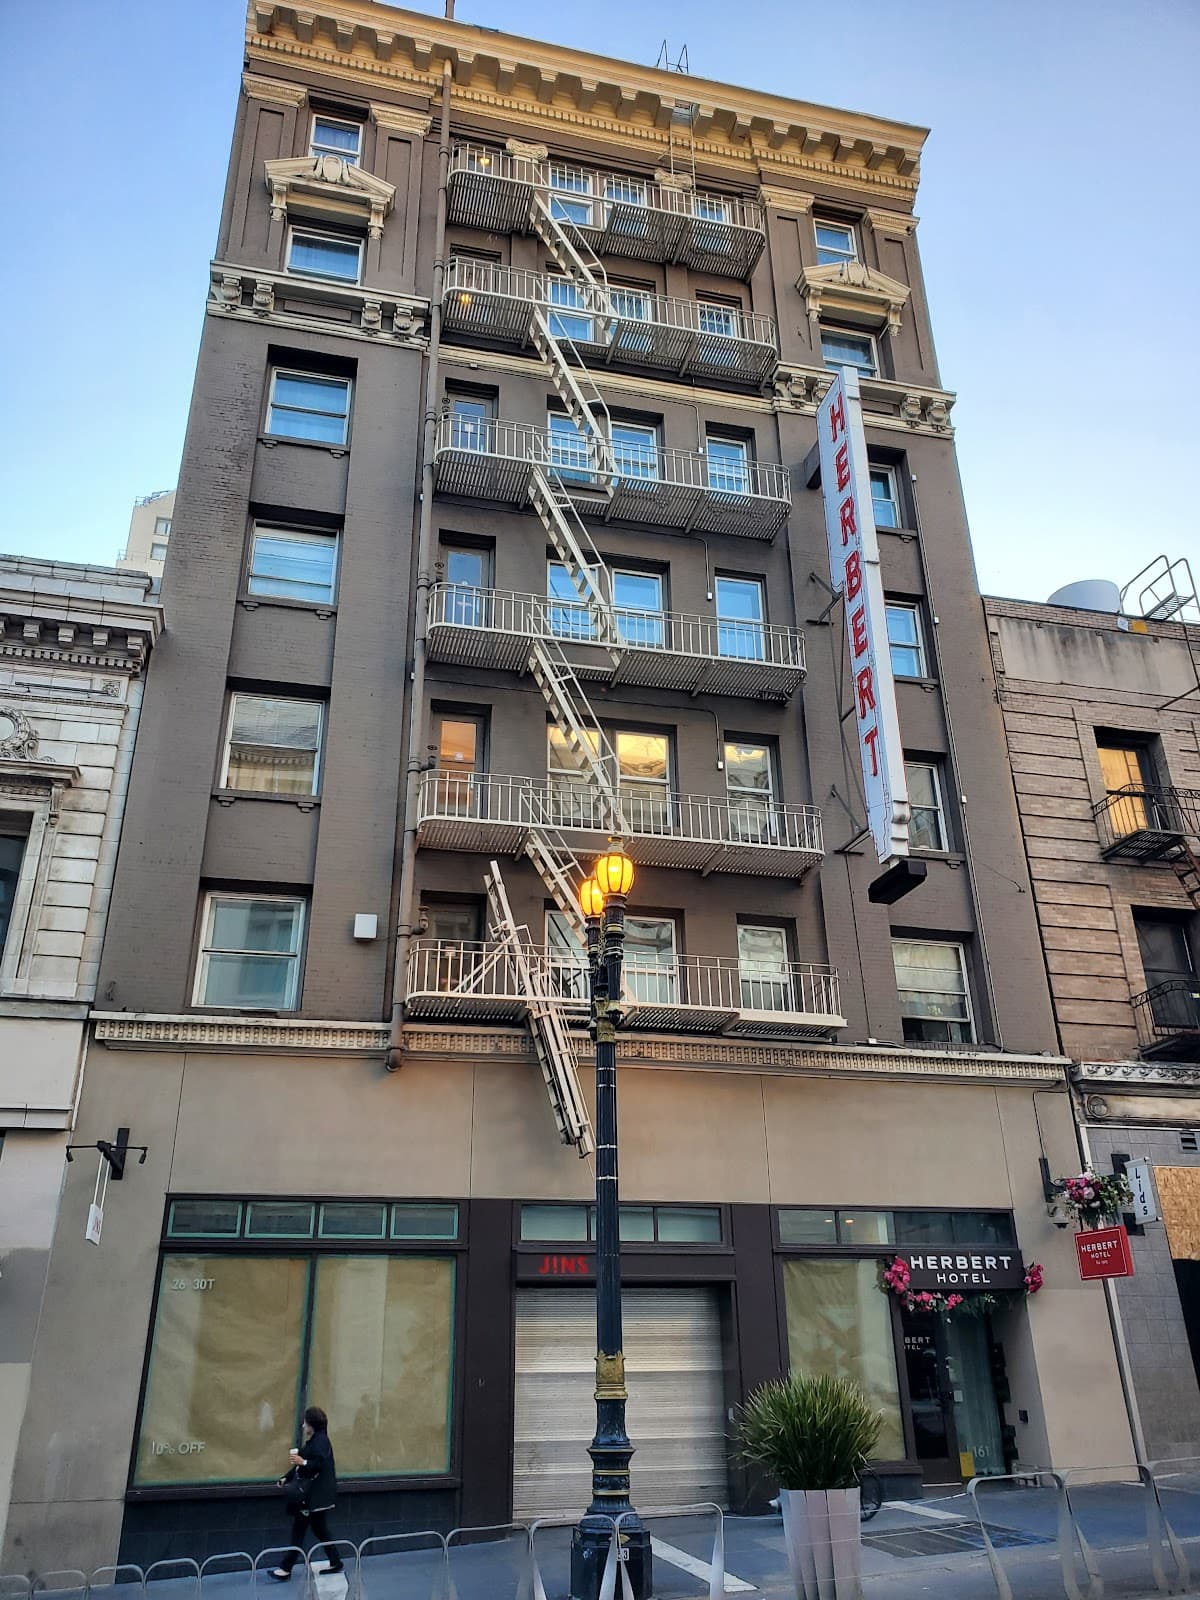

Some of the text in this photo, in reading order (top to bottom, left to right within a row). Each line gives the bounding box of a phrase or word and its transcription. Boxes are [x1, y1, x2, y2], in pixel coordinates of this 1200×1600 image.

[827, 391, 878, 777] HERBERT
[1135, 1167, 1148, 1216] Lids
[1080, 1240, 1118, 1253] HERBERT
[1090, 1250, 1112, 1259] HOTEL
[538, 1255, 588, 1274] JINS
[910, 1255, 1012, 1271] HERBERT
[936, 1273, 991, 1284] HOTEL
[904, 1336, 931, 1344] BERT
[178, 1441, 206, 1455] OFF
[973, 1446, 990, 1458] 161
